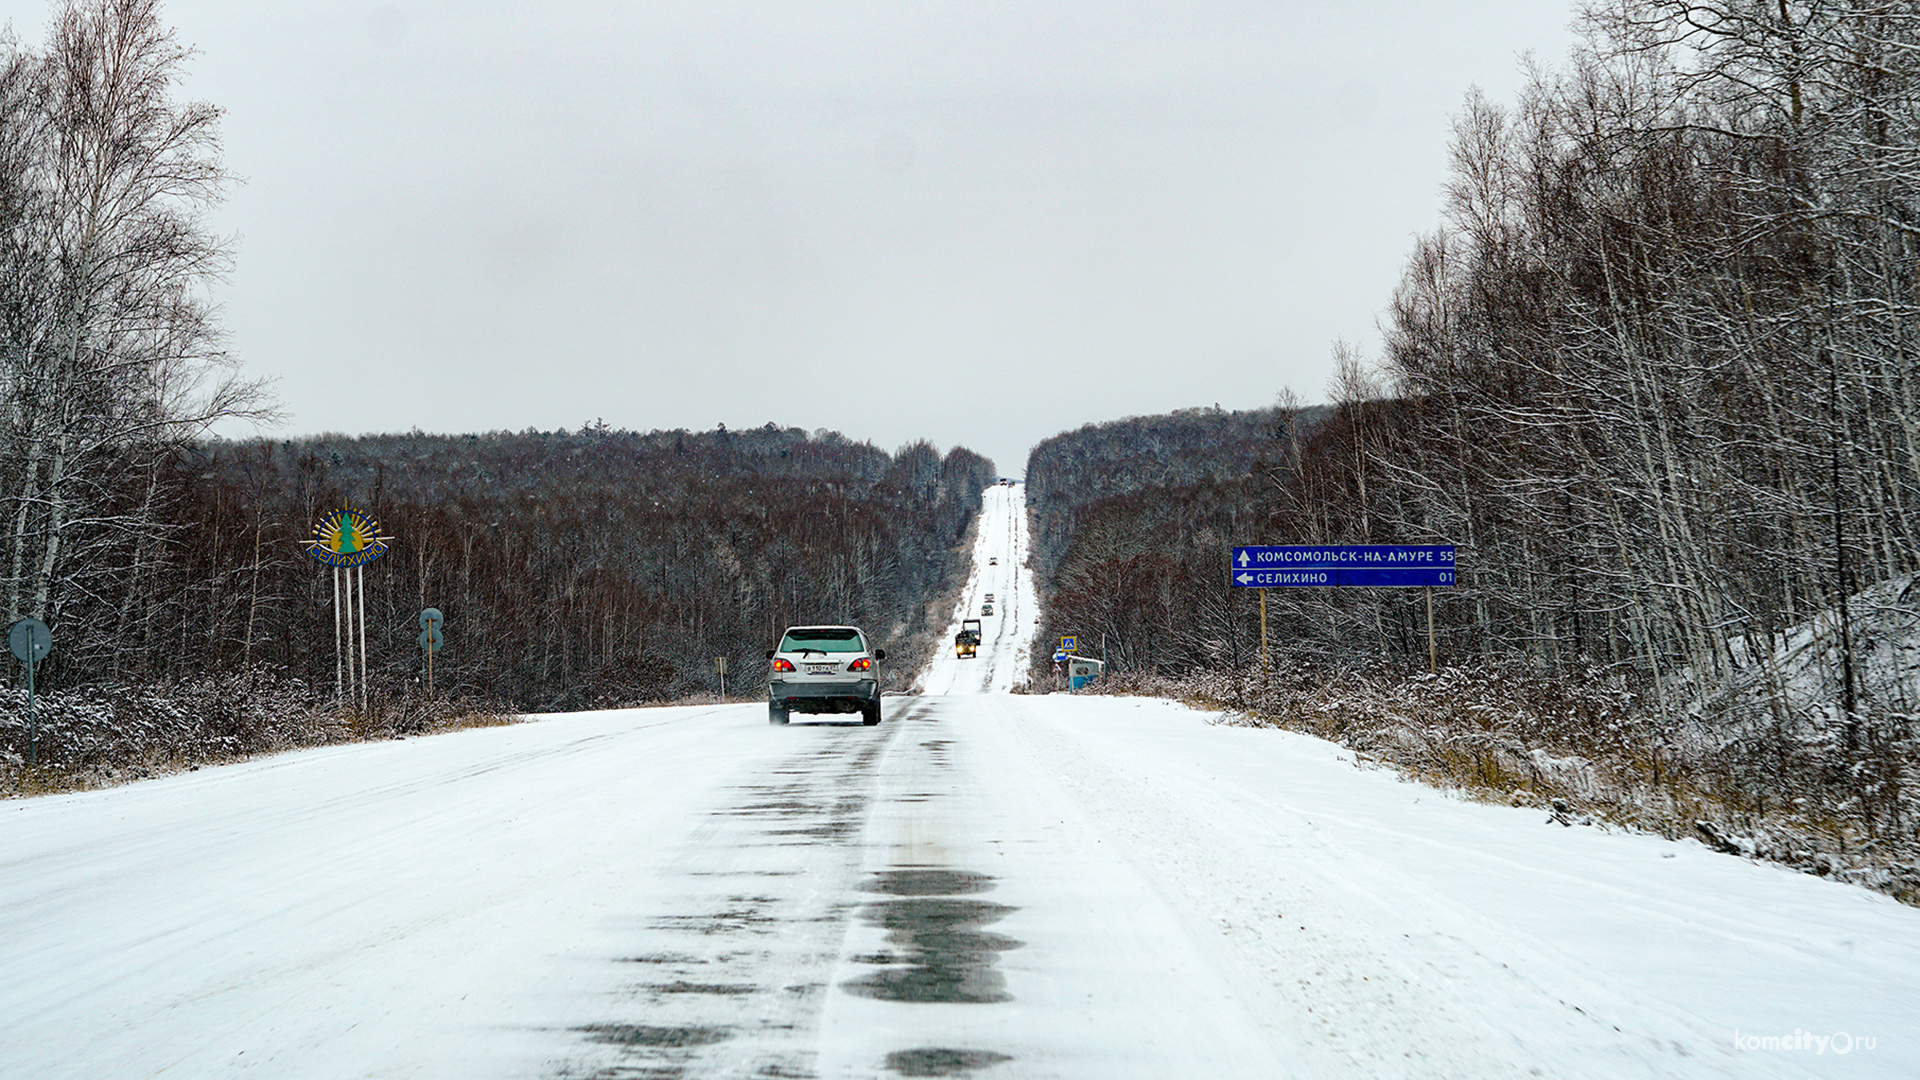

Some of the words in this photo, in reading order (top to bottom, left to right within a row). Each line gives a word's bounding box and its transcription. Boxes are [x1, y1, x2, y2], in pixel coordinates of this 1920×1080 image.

[310, 543, 384, 566] СЕЛИХИНО
[1256, 551, 1433, 562] КОМСОМОЛЬСК-НА-АМУРЕ
[1439, 550, 1455, 561] 55
[1256, 572, 1328, 583] СЕЛИХИНО
[1438, 572, 1454, 582] 01
